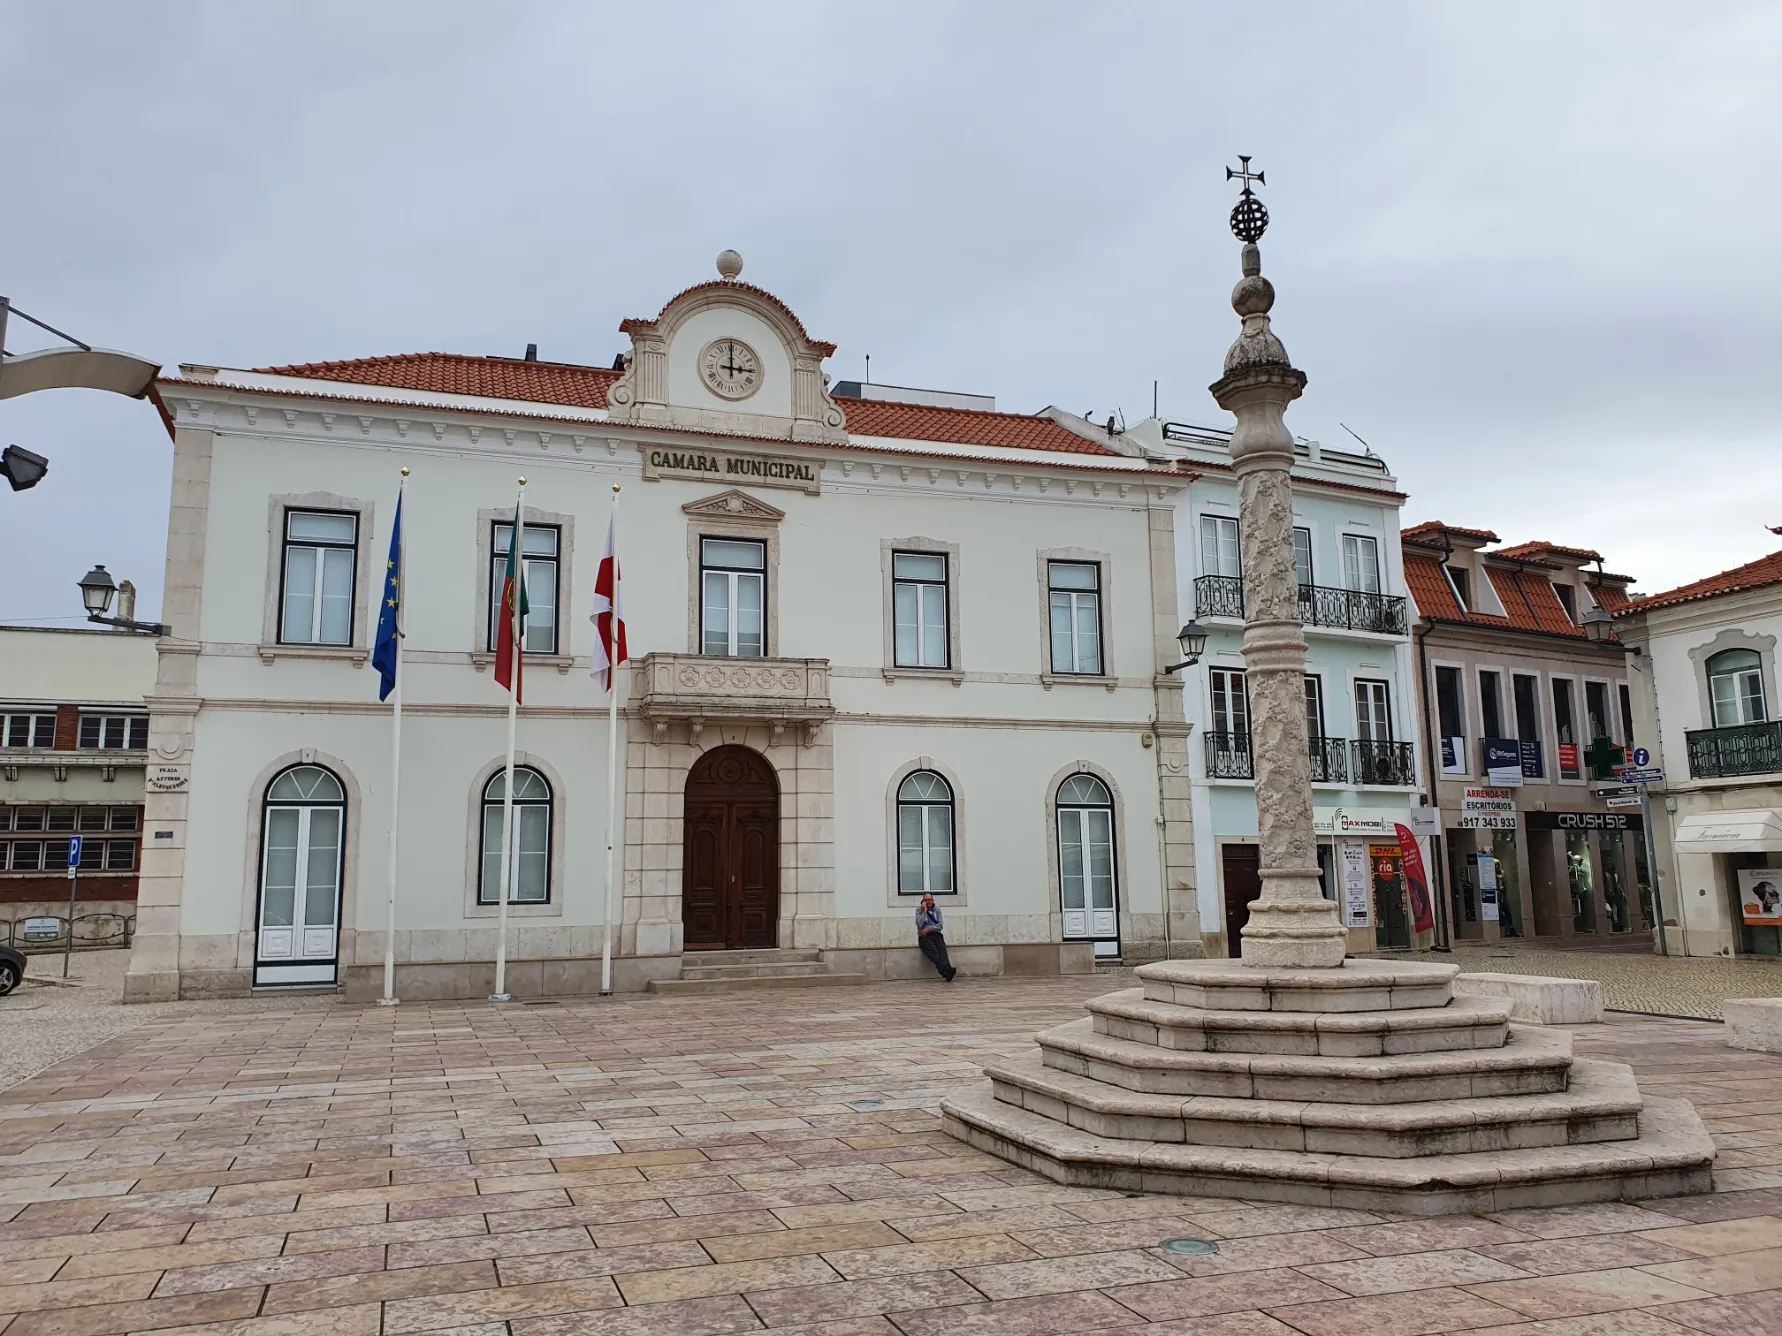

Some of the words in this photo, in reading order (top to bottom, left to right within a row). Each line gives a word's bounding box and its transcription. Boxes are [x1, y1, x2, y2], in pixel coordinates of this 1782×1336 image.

[651, 451, 720, 473] CAMARA
[726, 458, 815, 481] MUNICIPAL
[1466, 789, 1510, 799] ARRENDA-SE
[1466, 800, 1512, 810] ESCRITÓRIOS
[1463, 816, 1480, 828] 917
[1482, 817, 1498, 828] 343
[1500, 817, 1516, 828] 933
[1557, 813, 1604, 828] CRUSH
[1606, 814, 1628, 829] 512
[1692, 826, 1741, 840] Farmácia
[69, 839, 78, 863] P
[1379, 859, 1392, 872] ria
